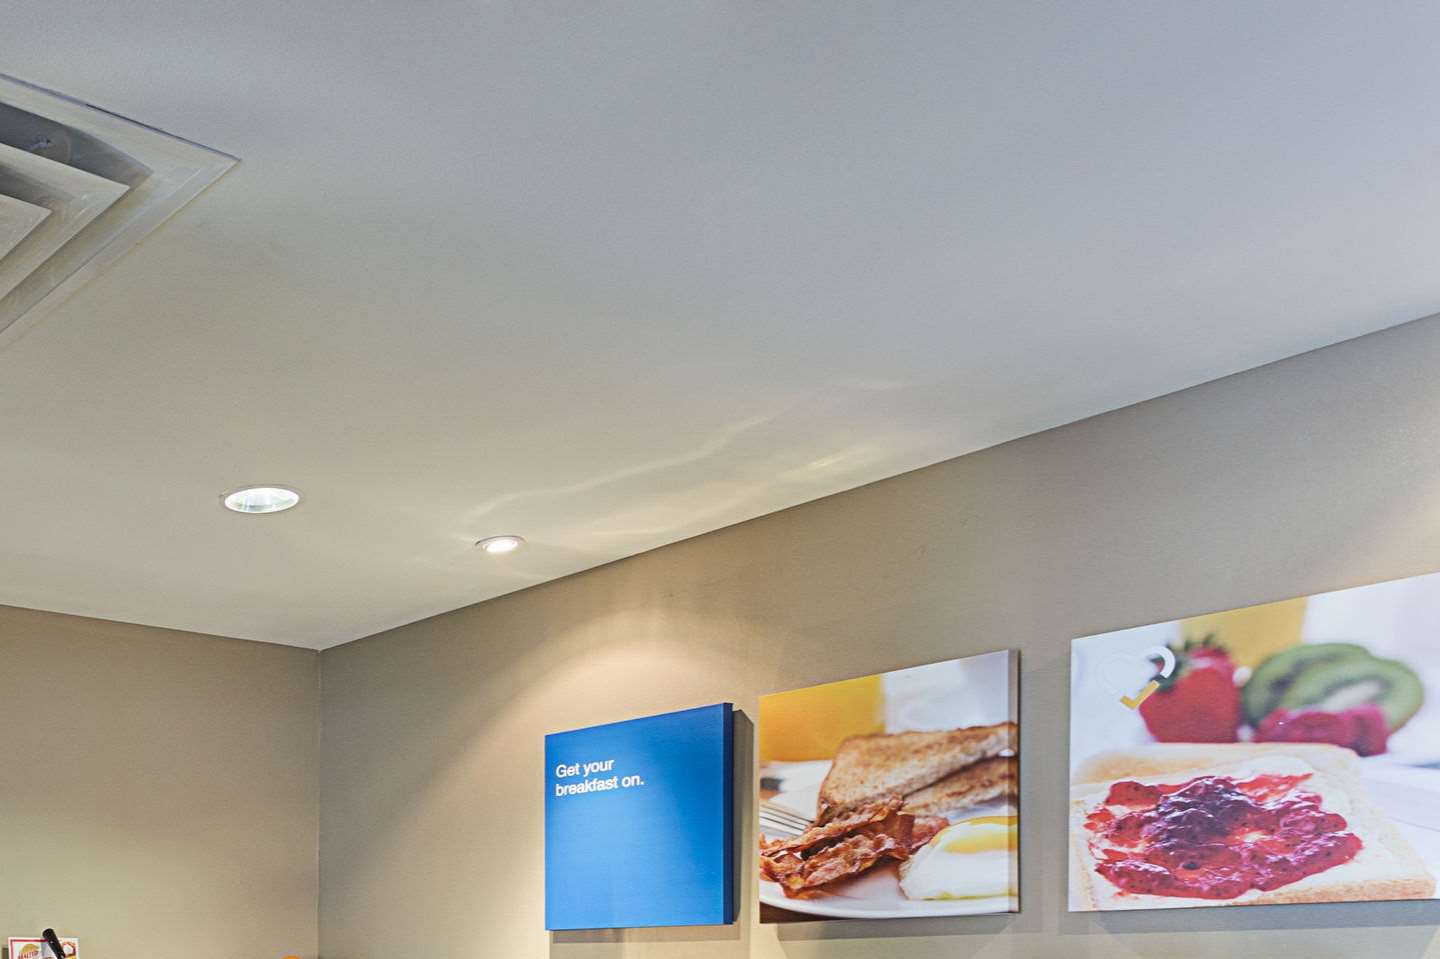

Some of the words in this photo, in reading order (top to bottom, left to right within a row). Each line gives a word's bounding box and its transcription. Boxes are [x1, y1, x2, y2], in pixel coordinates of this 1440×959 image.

[556, 763, 580, 778] Get
[583, 759, 615, 777] your
[555, 776, 619, 797] breakfast
[621, 775, 645, 788] on.
